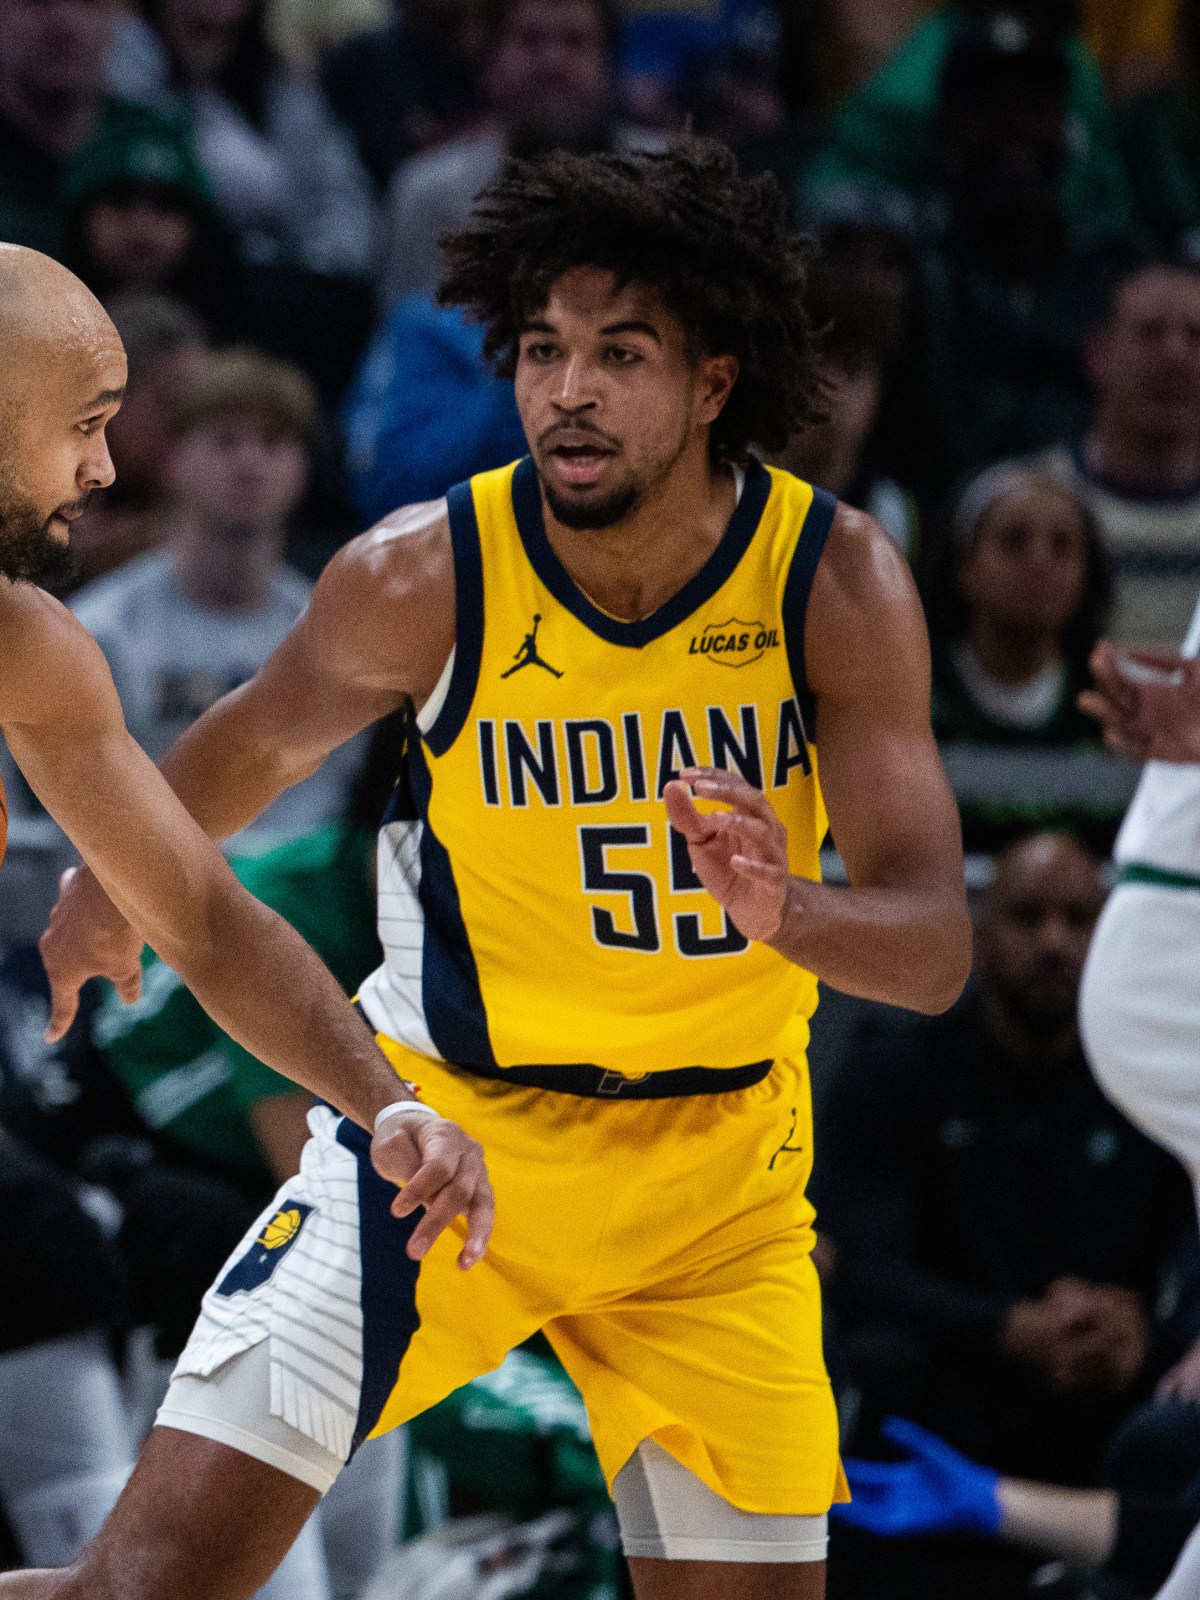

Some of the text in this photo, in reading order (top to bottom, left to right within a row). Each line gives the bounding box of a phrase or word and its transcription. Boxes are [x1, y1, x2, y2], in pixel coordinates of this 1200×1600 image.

[688, 629, 780, 655] LUCAS OIL
[477, 697, 812, 808] INDIANA
